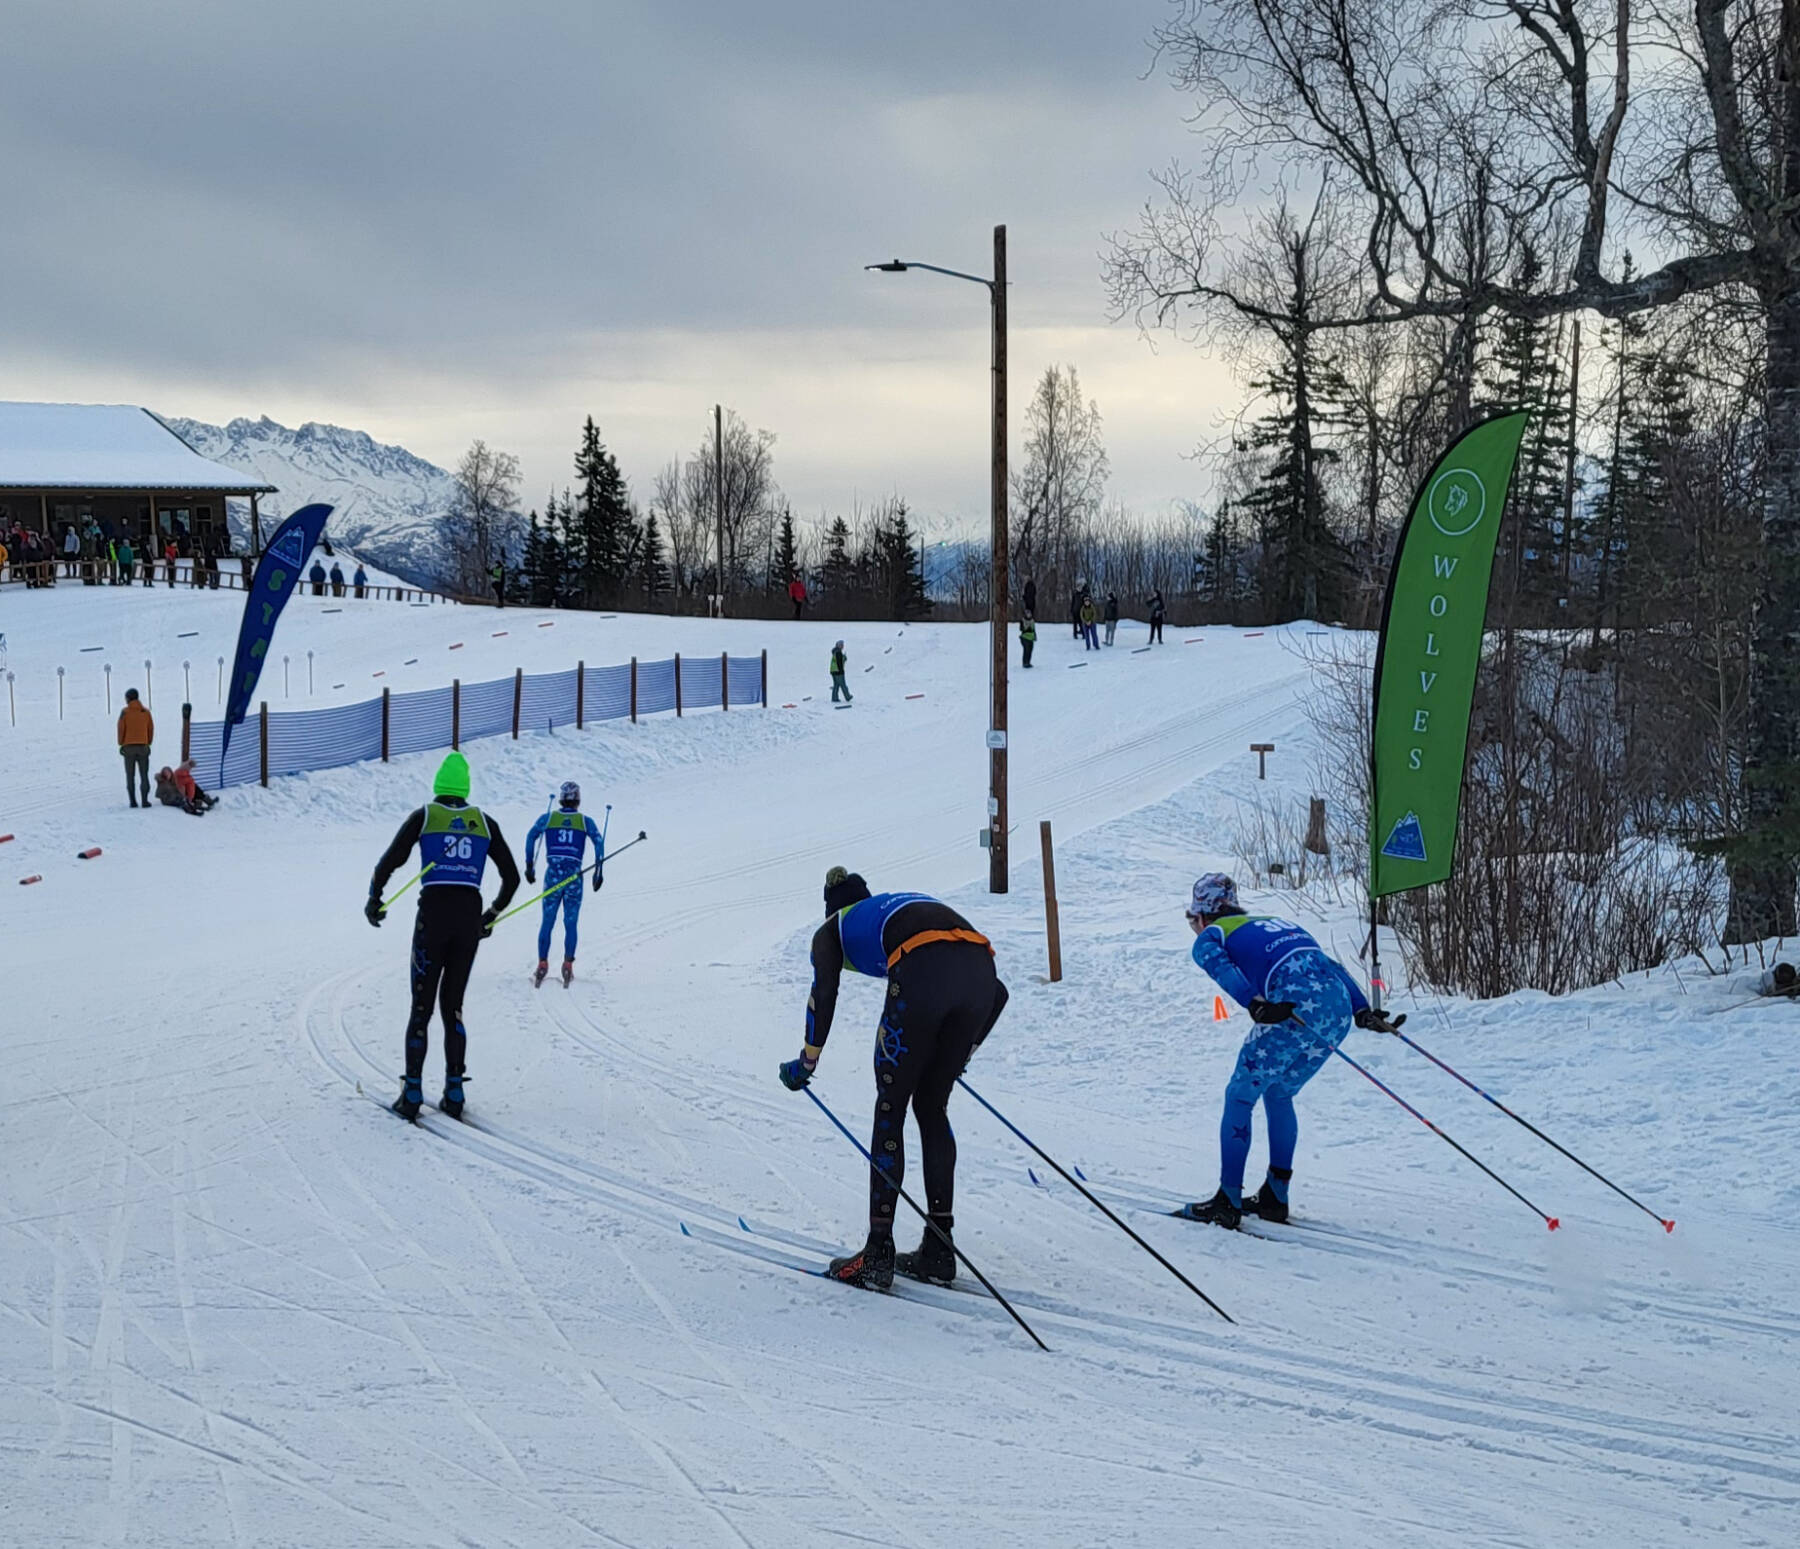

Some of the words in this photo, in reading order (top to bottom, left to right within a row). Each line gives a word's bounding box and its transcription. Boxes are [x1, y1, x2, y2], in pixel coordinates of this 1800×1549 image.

[1407, 553, 1460, 771] WOLVES
[557, 828, 574, 844] 31
[443, 835, 473, 860] 36
[1253, 918, 1298, 933] 30
